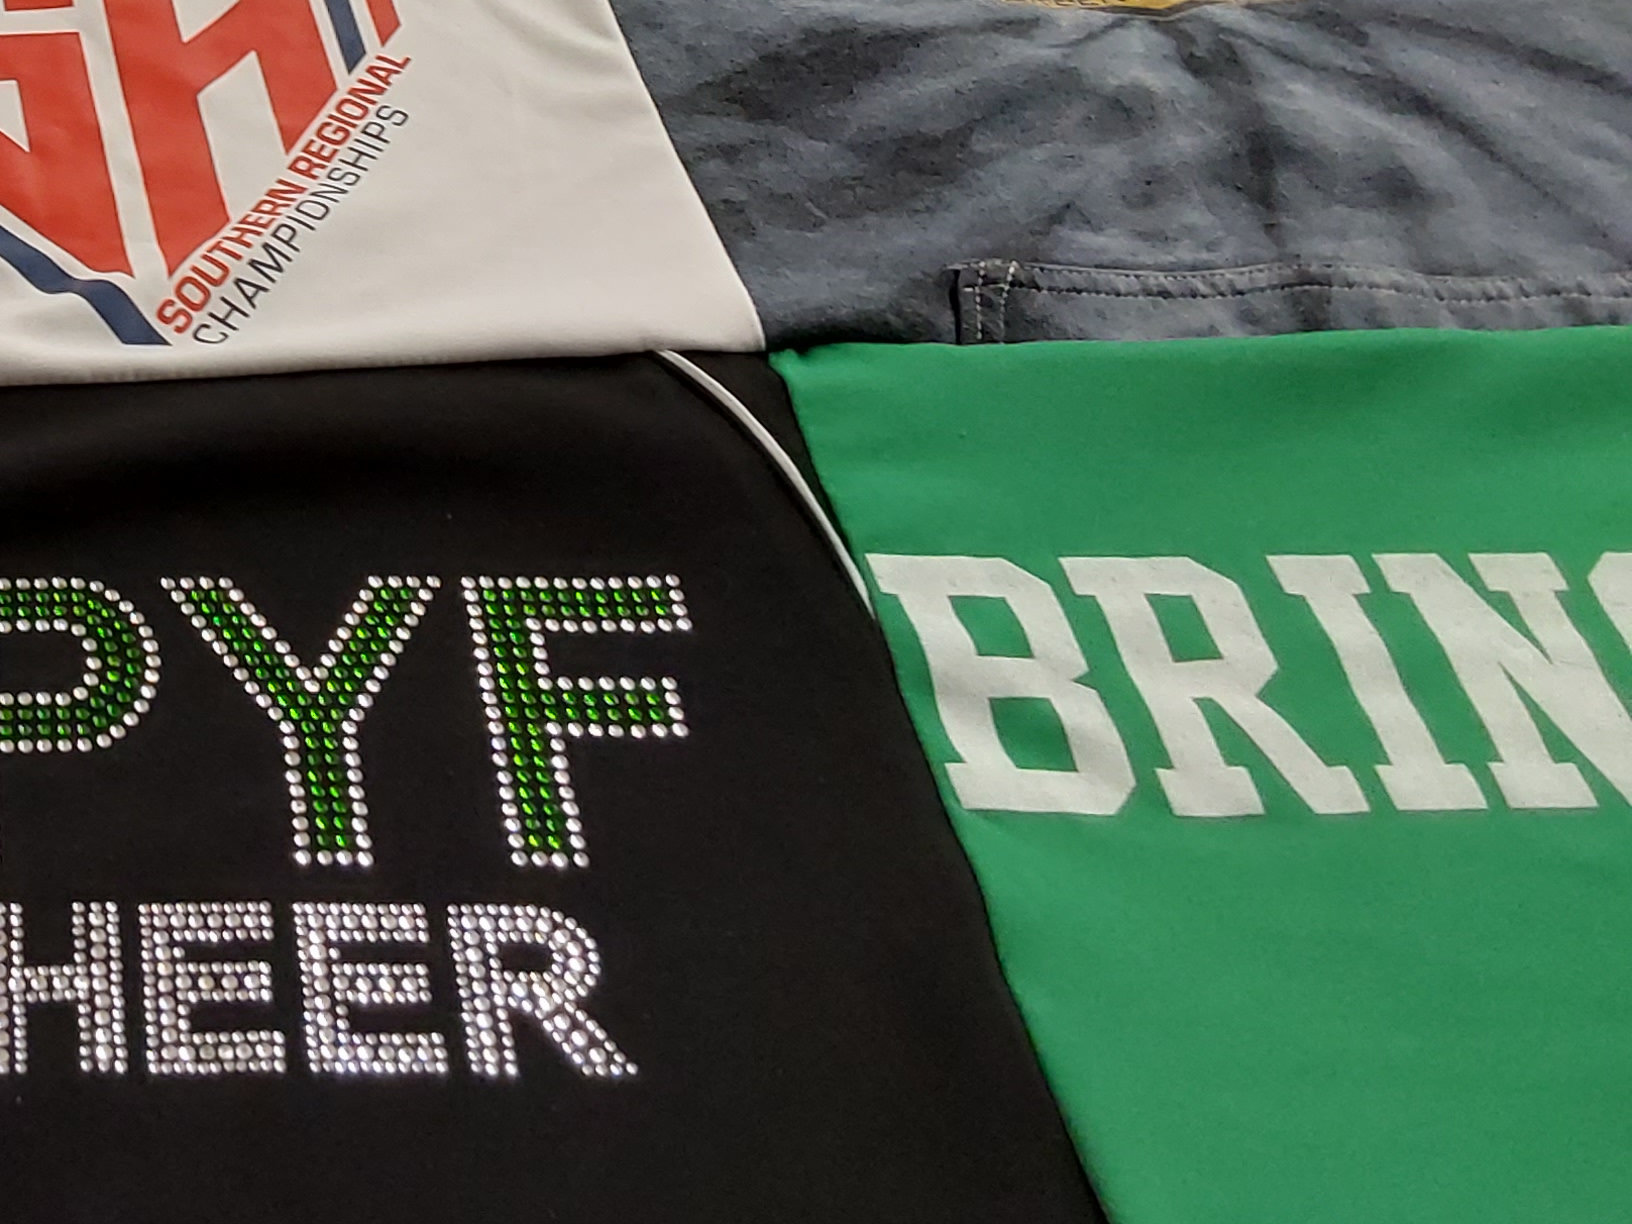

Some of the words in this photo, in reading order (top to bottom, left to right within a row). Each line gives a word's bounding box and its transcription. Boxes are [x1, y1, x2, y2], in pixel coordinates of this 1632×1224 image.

[156, 179, 307, 334] SOUTHERN
[287, 49, 412, 181] REGIONAL
[193, 104, 410, 348] CHAMPIONSHIPS
[863, 551, 1632, 819] BRIN
